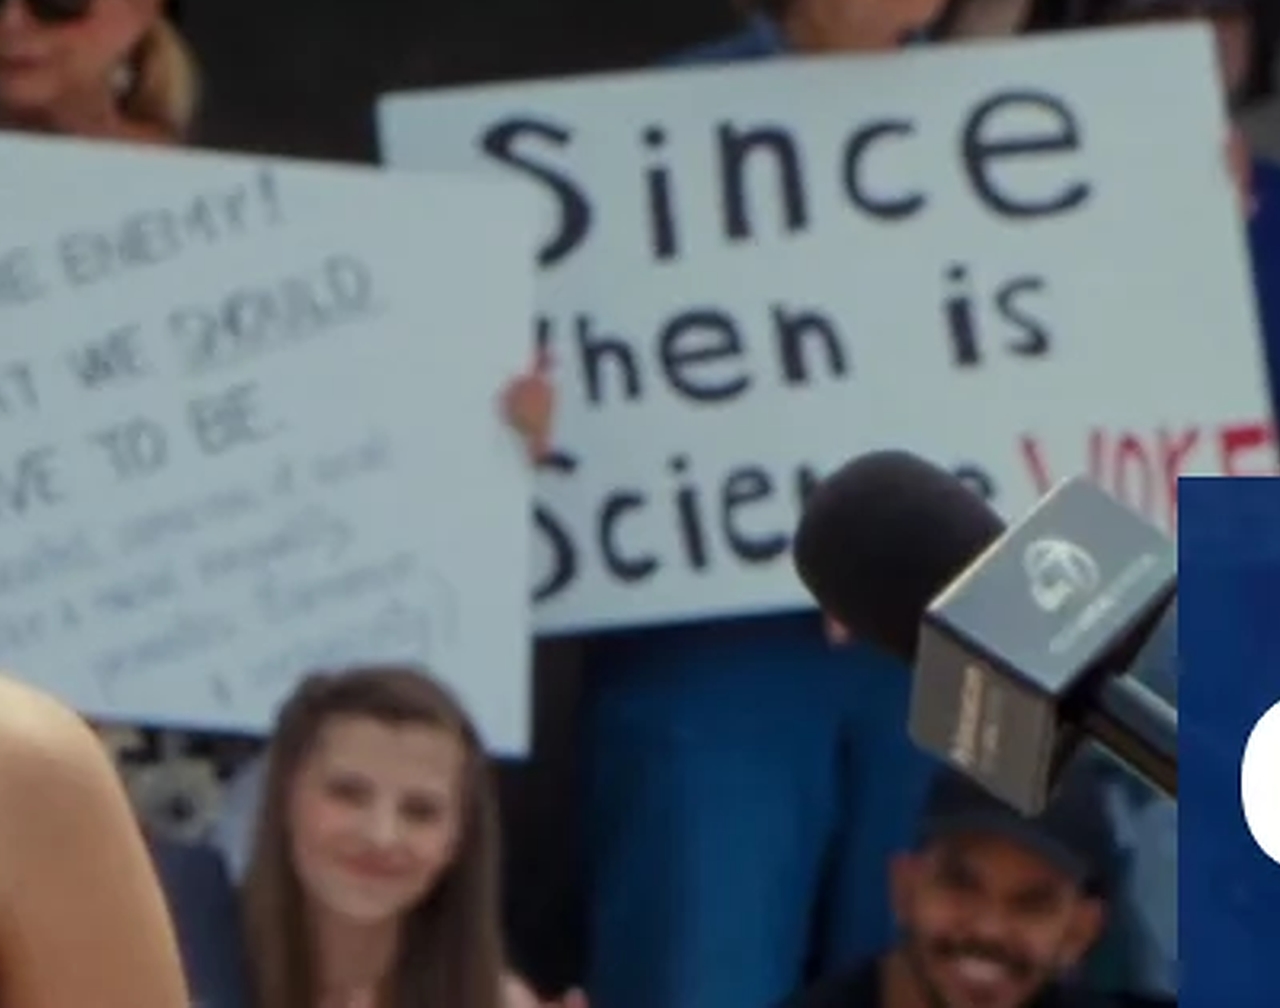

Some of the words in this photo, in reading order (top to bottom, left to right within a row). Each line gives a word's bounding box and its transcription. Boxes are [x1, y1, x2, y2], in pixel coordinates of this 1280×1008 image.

[476, 88, 1094, 271] Since
[67, 318, 154, 390] WE
[167, 254, 376, 372] SHOULD
[534, 301, 850, 405] hen
[942, 263, 1054, 368] is
[86, 414, 169, 478] TO
